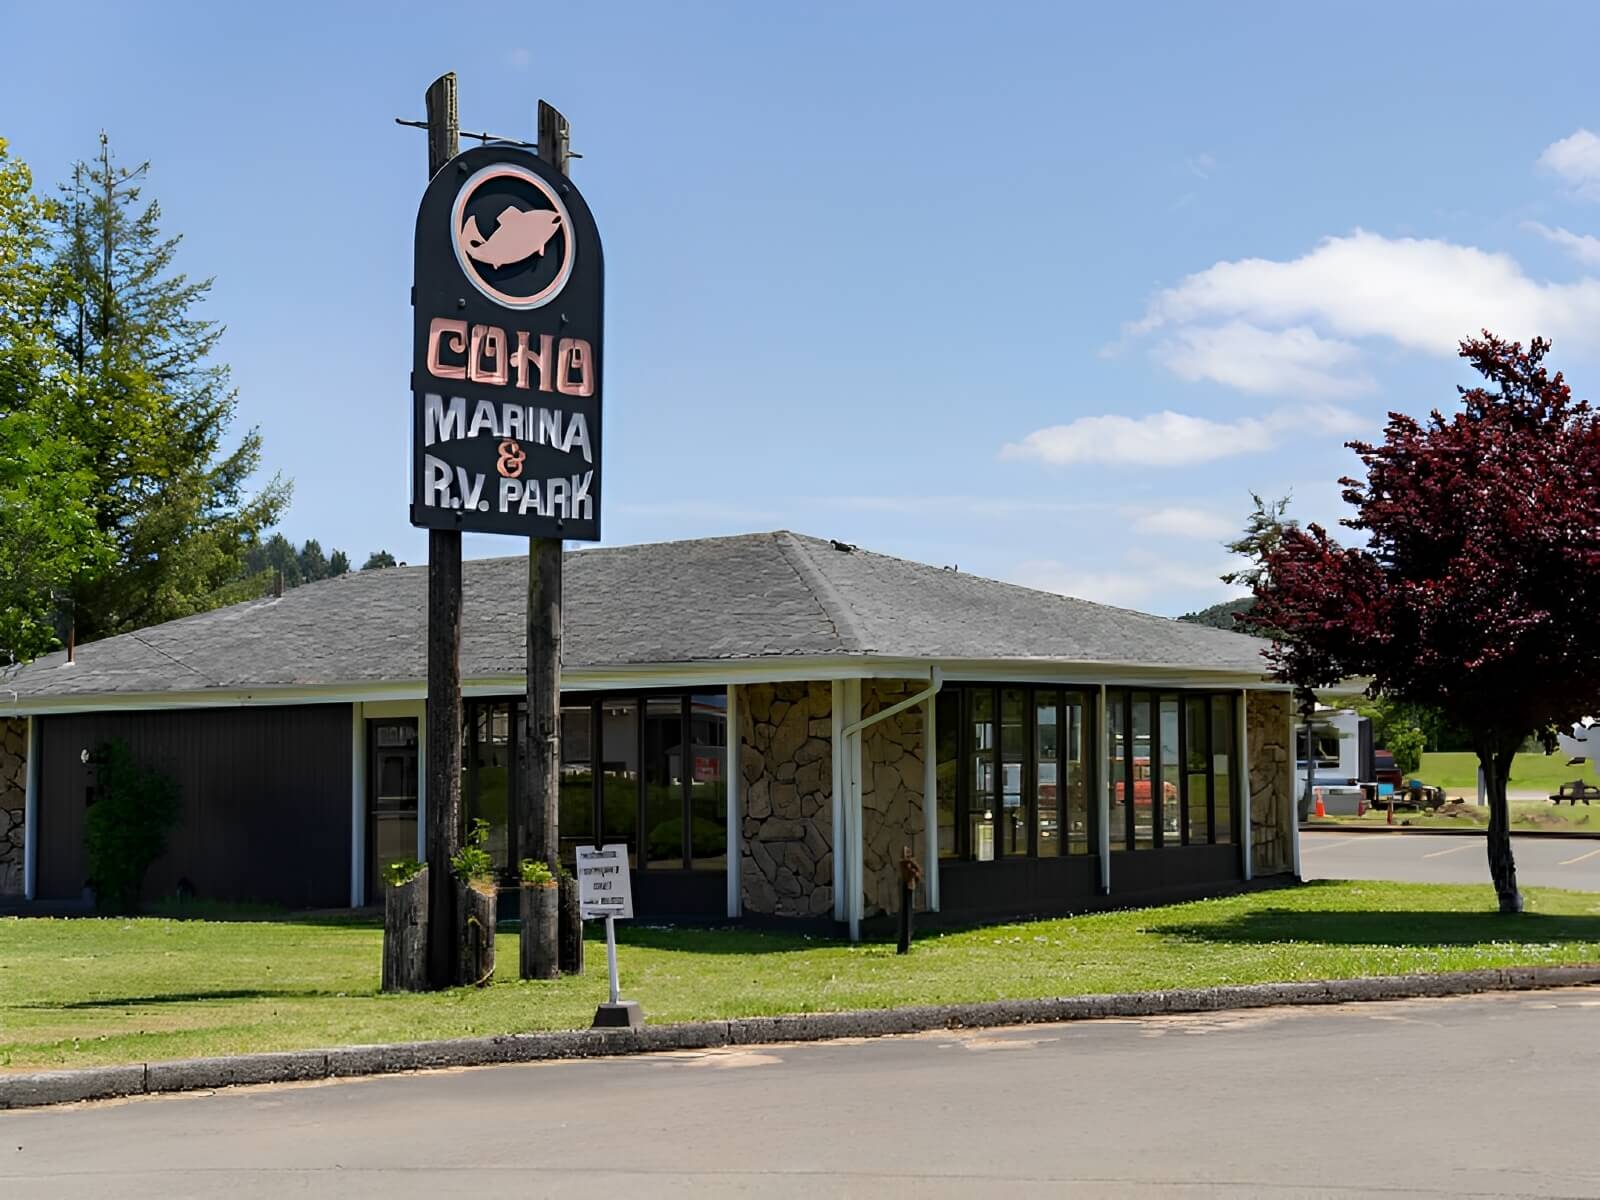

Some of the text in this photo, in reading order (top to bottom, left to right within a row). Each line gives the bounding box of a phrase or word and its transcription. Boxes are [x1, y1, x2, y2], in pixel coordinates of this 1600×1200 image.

[427, 317, 594, 397] COHO
[425, 393, 592, 463] MARINA
[497, 438, 526, 478] &
[425, 453, 594, 519] R.V. PARK
